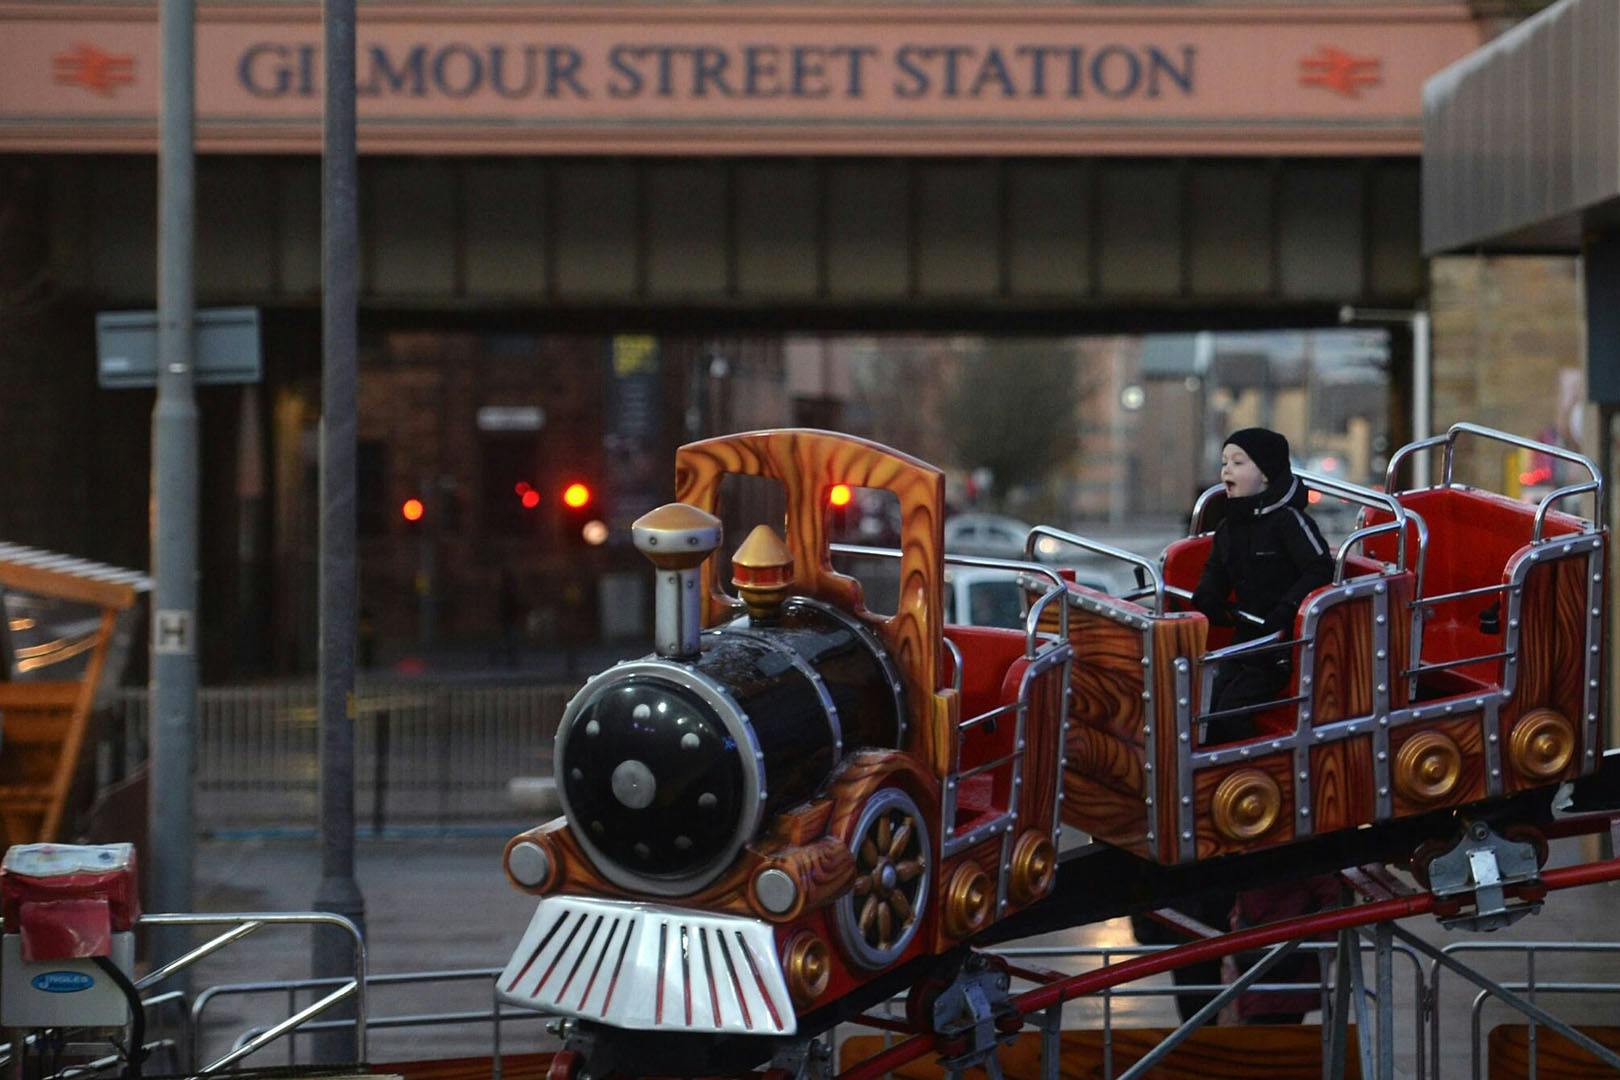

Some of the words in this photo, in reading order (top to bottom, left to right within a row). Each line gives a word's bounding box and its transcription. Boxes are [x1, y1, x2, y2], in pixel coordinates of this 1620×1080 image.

[237, 42, 590, 99] GIMOUR
[607, 42, 876, 98] STREET
[895, 43, 1197, 98] STATION
[159, 615, 186, 647] H
